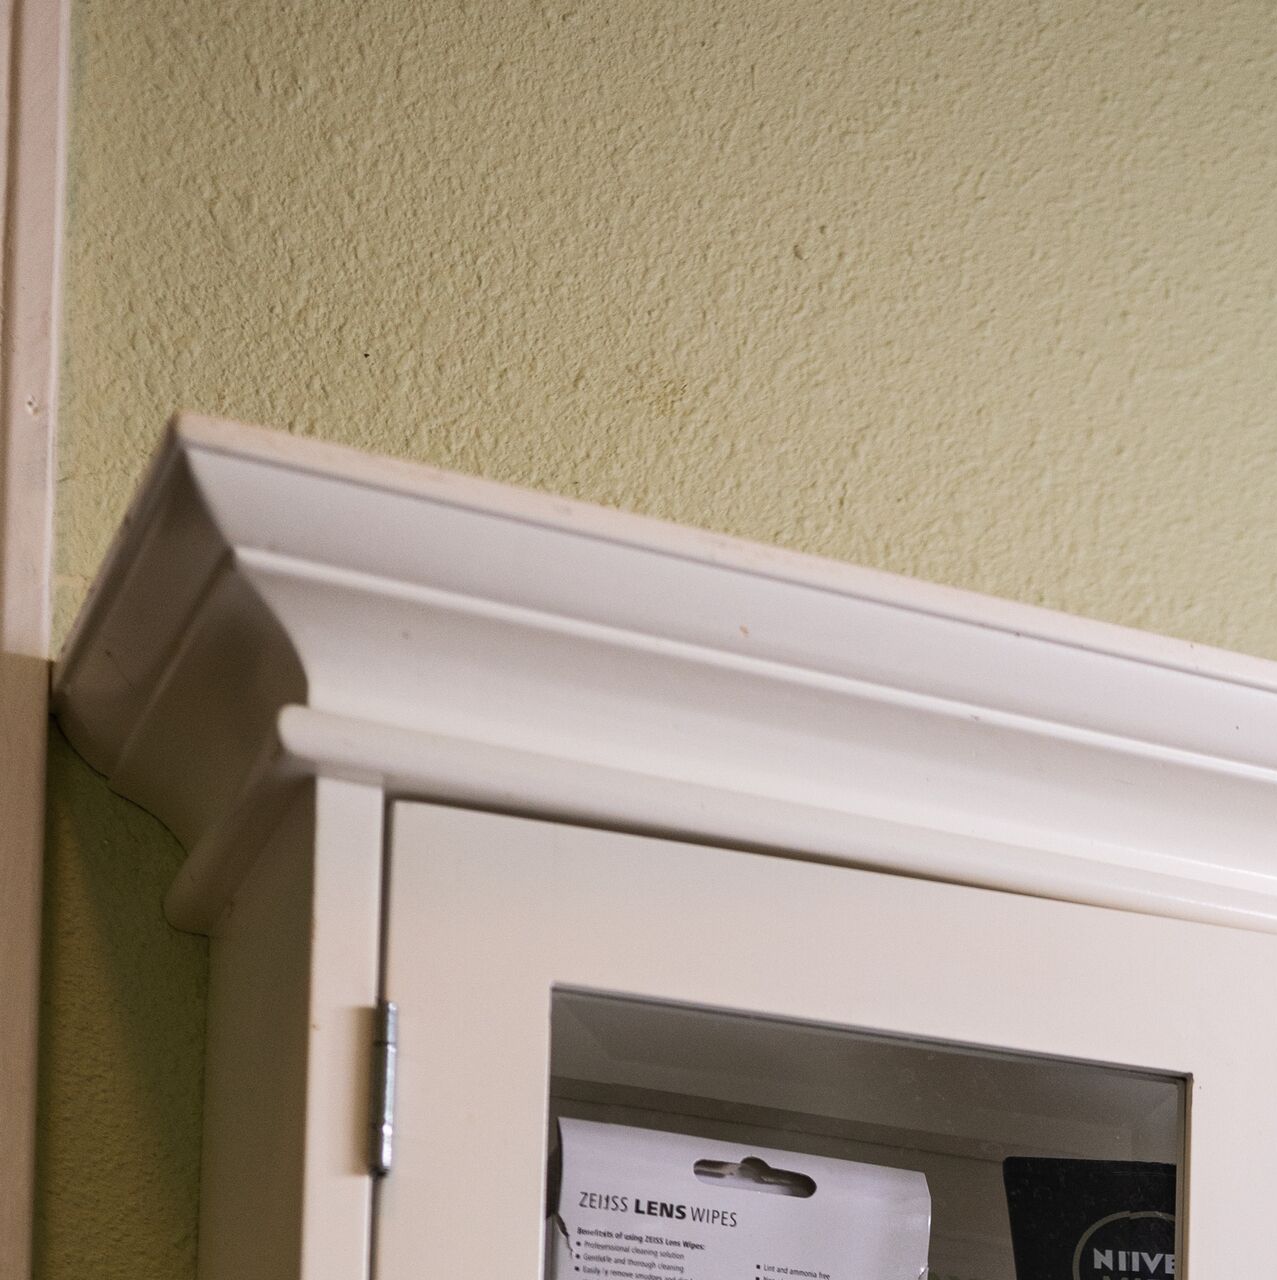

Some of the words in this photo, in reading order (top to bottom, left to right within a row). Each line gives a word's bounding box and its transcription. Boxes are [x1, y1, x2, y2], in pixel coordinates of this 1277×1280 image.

[635, 1199, 687, 1220] LENS
[691, 1206, 737, 1227] WIPES
[624, 1233, 643, 1243] using
[645, 1236, 663, 1244] ZEISS
[666, 1238, 681, 1246] Lens
[683, 1240, 705, 1250] Wipes:
[763, 1264, 775, 1272] Lint
[777, 1266, 788, 1274] and
[789, 1269, 817, 1278] ammonia
[819, 1272, 830, 1280] free
